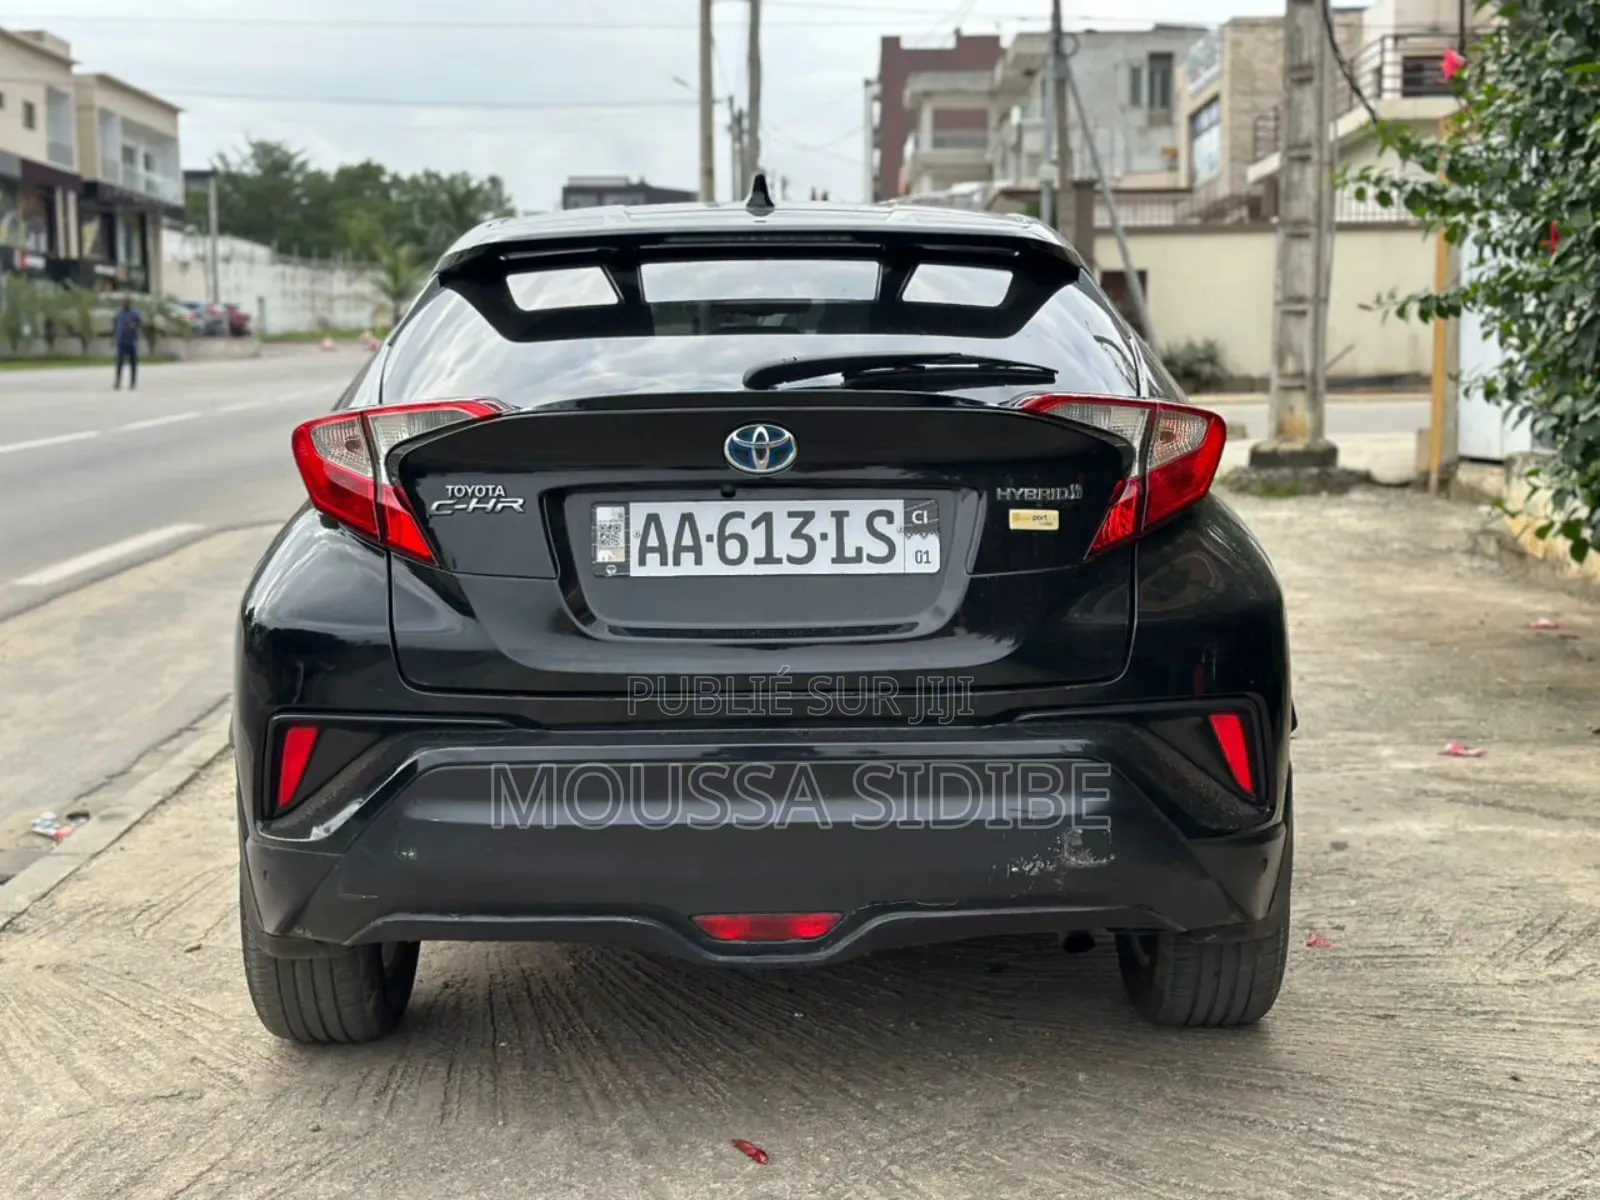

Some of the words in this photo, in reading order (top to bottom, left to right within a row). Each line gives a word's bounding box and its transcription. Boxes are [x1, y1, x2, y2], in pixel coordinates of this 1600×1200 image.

[445, 484, 505, 497] TOYOTA
[996, 487, 1068, 501] HYBRID
[430, 498, 525, 515] C-HR
[912, 510, 928, 524] CI
[914, 549, 932, 565] 01
